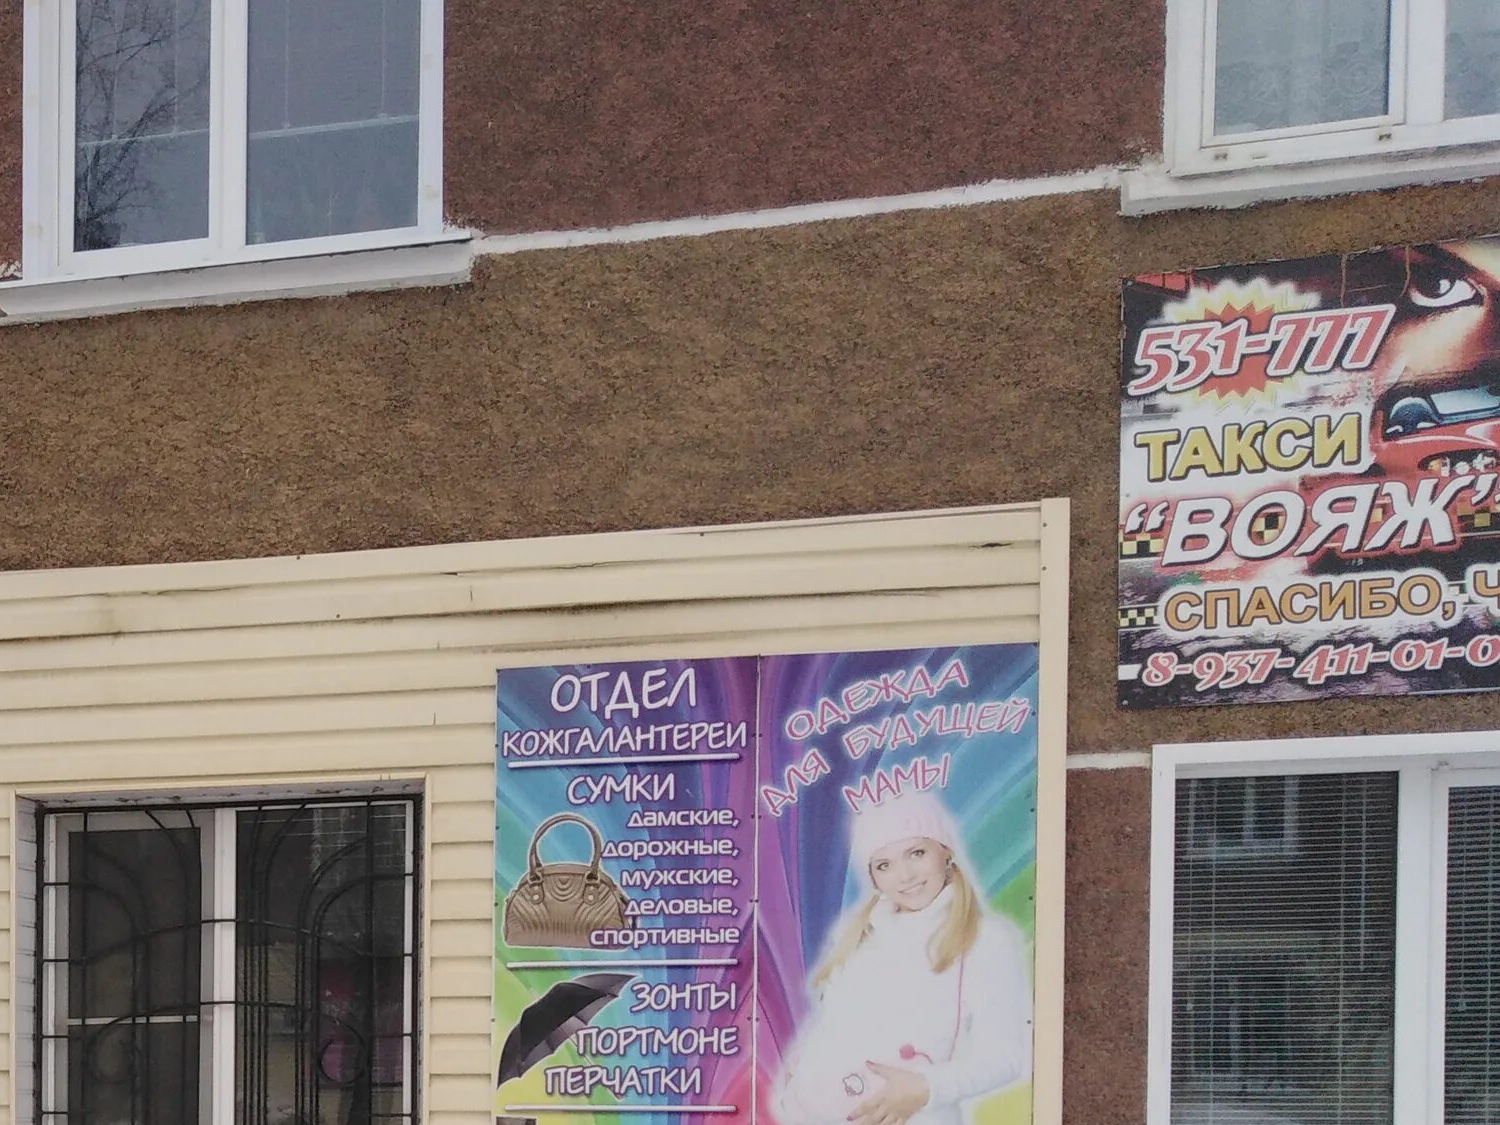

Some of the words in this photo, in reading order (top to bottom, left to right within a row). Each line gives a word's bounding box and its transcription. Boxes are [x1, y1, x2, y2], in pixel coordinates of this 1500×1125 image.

[1128, 304, 1396, 395] 531-777
[1135, 412, 1360, 481] ТАКСИ
[1164, 574, 1455, 630] СПАСИБО,
[551, 668, 696, 719] ОТДЕЛ
[787, 660, 967, 741] ОДЕЖДА
[503, 722, 747, 756] КОЖГАЛАНТЕРЕИ
[762, 752, 830, 815] ДЛЯ
[845, 699, 1029, 757] БУДУЩЕЙ
[568, 773, 675, 804] СУМКИ
[845, 753, 950, 810] МАМЫ
[628, 808, 739, 828] дамские,
[602, 837, 739, 860] дорожные,
[621, 868, 739, 888] мужские,
[625, 898, 739, 917] деловые,
[591, 926, 739, 946] спортивные
[630, 983, 736, 1011] ЗОНТЫ
[576, 1028, 738, 1056] ПОРТМОНЕ
[546, 1067, 701, 1096] ПЕРЧАТКИ
